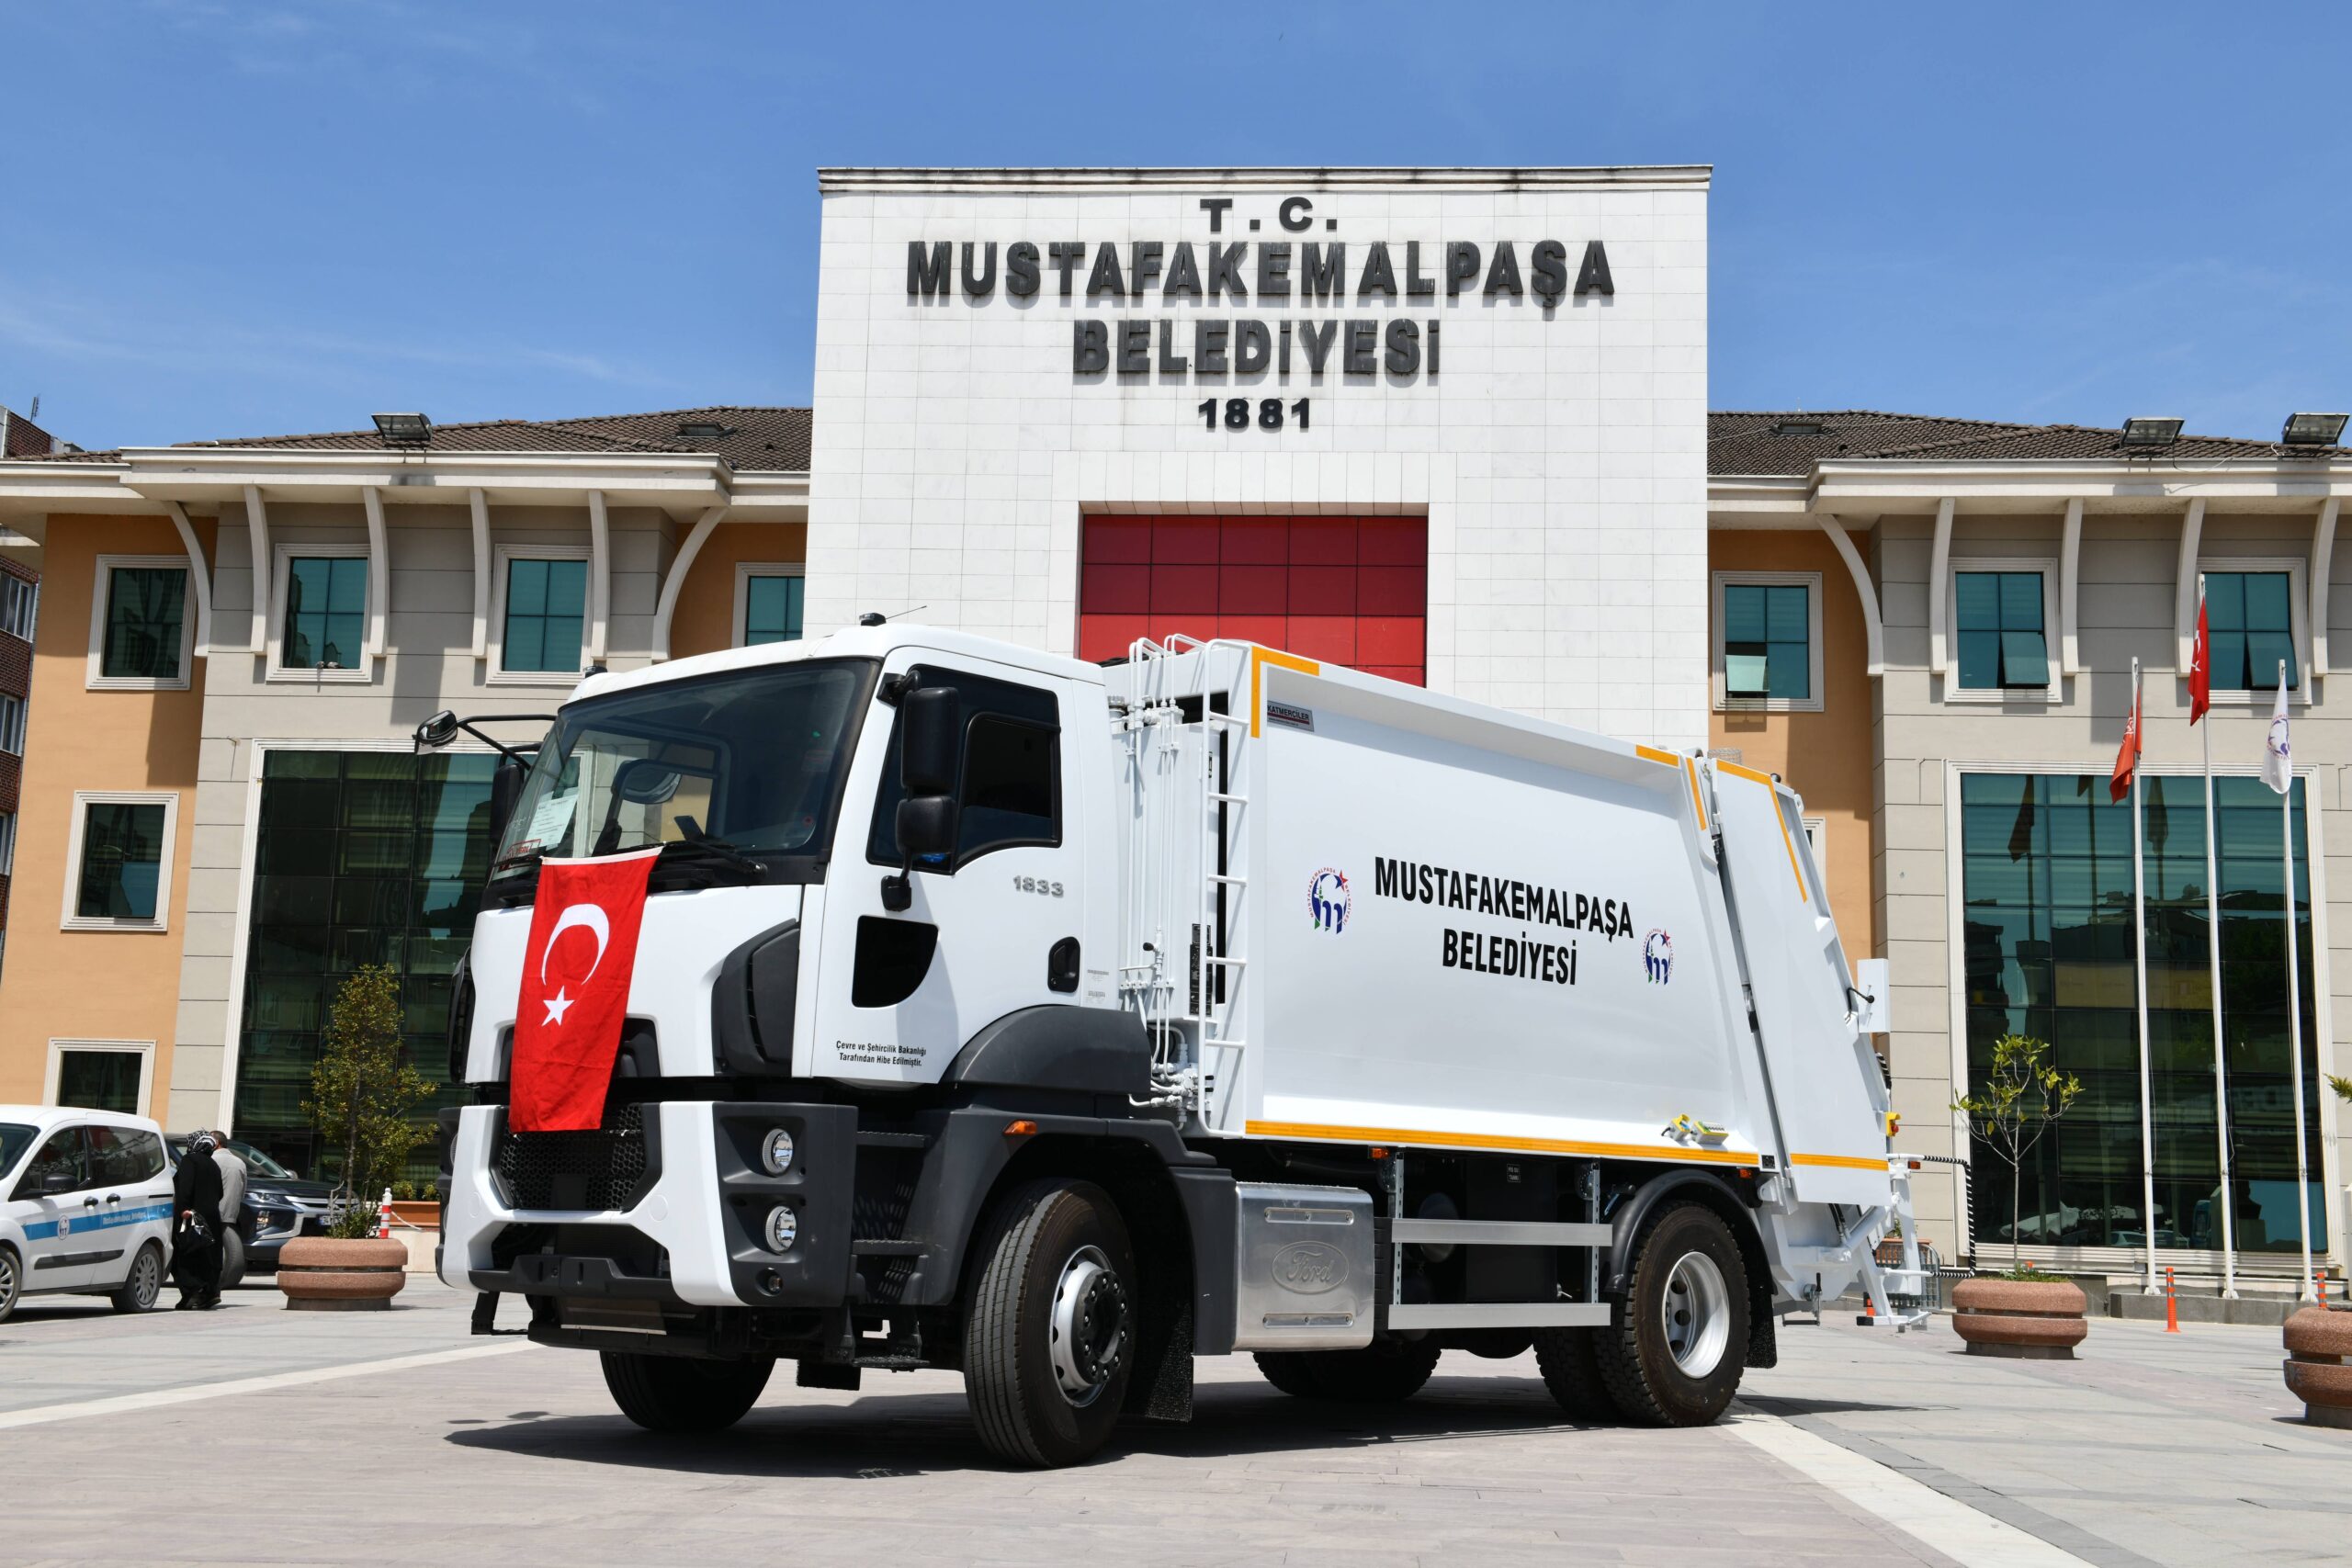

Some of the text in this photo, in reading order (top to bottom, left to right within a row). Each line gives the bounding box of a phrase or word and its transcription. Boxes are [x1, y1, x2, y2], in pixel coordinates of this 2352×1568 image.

[907, 239, 1615, 309] MUSTAFAKEMALPAŞA
[1073, 318, 1440, 377] BELEDİYESİ
[1198, 398, 1311, 430] 1881
[1267, 705, 1309, 720] KATMERCİLER
[1012, 874, 1064, 898] 1833
[1374, 855, 1634, 943] MUSTAFAKEMALPAŞA
[1442, 928, 1577, 986] BELEDİYESİ
[836, 1040, 856, 1051] Çevre
[867, 1043, 897, 1054] Şehircilik
[898, 1045, 927, 1057] Bakanlığı
[839, 1052, 875, 1064] Tarafından
[876, 1055, 891, 1065] Hibe
[1286, 1250, 1335, 1283] Ford
